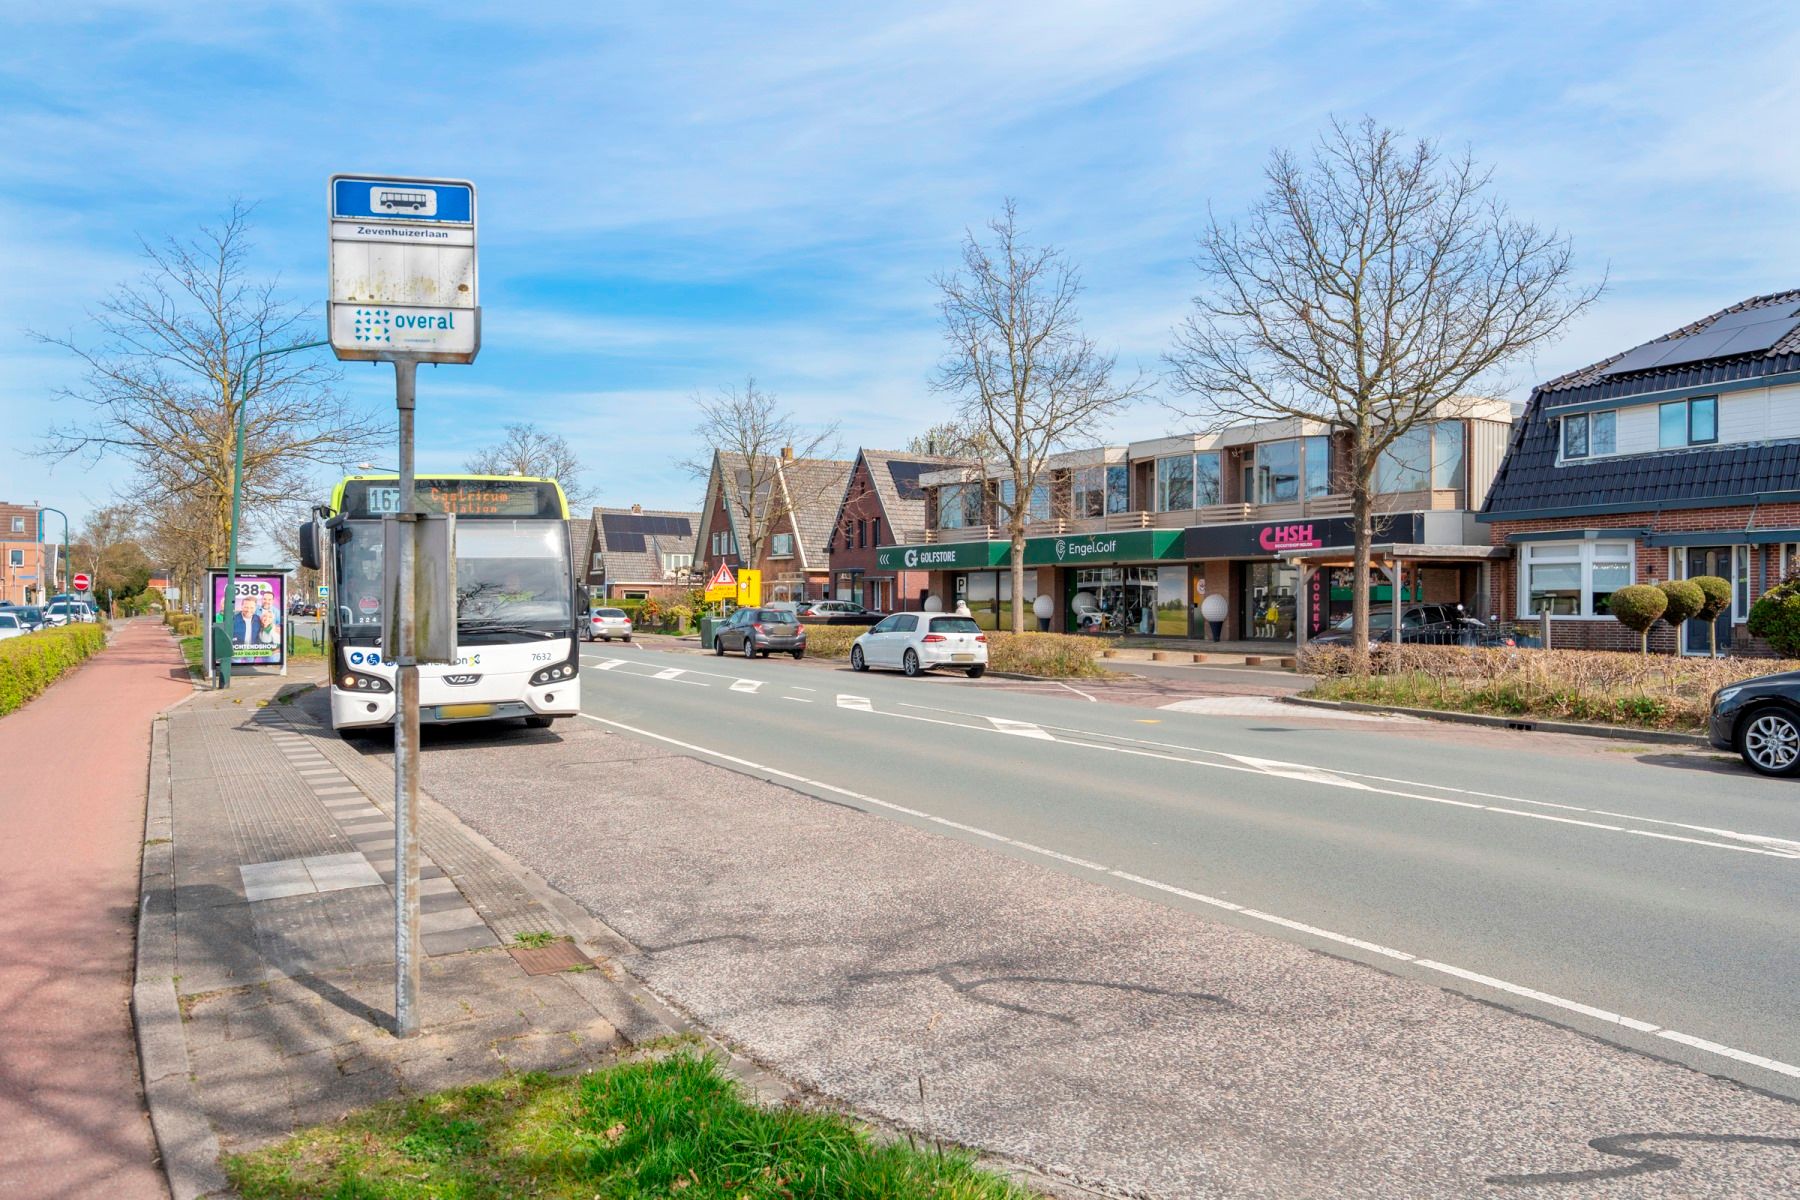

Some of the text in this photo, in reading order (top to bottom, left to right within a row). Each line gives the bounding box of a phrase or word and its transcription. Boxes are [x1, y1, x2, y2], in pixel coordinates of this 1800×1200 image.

[358, 227, 448, 238] Zevenhuizerlaan
[395, 312, 454, 329] overal
[431, 487, 509, 502] Castricum
[443, 501, 498, 513] Station
[1069, 540, 1117, 556] Engel.Golf
[920, 550, 956, 563] GOLFSTORE
[1312, 572, 1321, 632] HOCKEY
[531, 652, 552, 661] 7632
[447, 675, 478, 684] VDL
